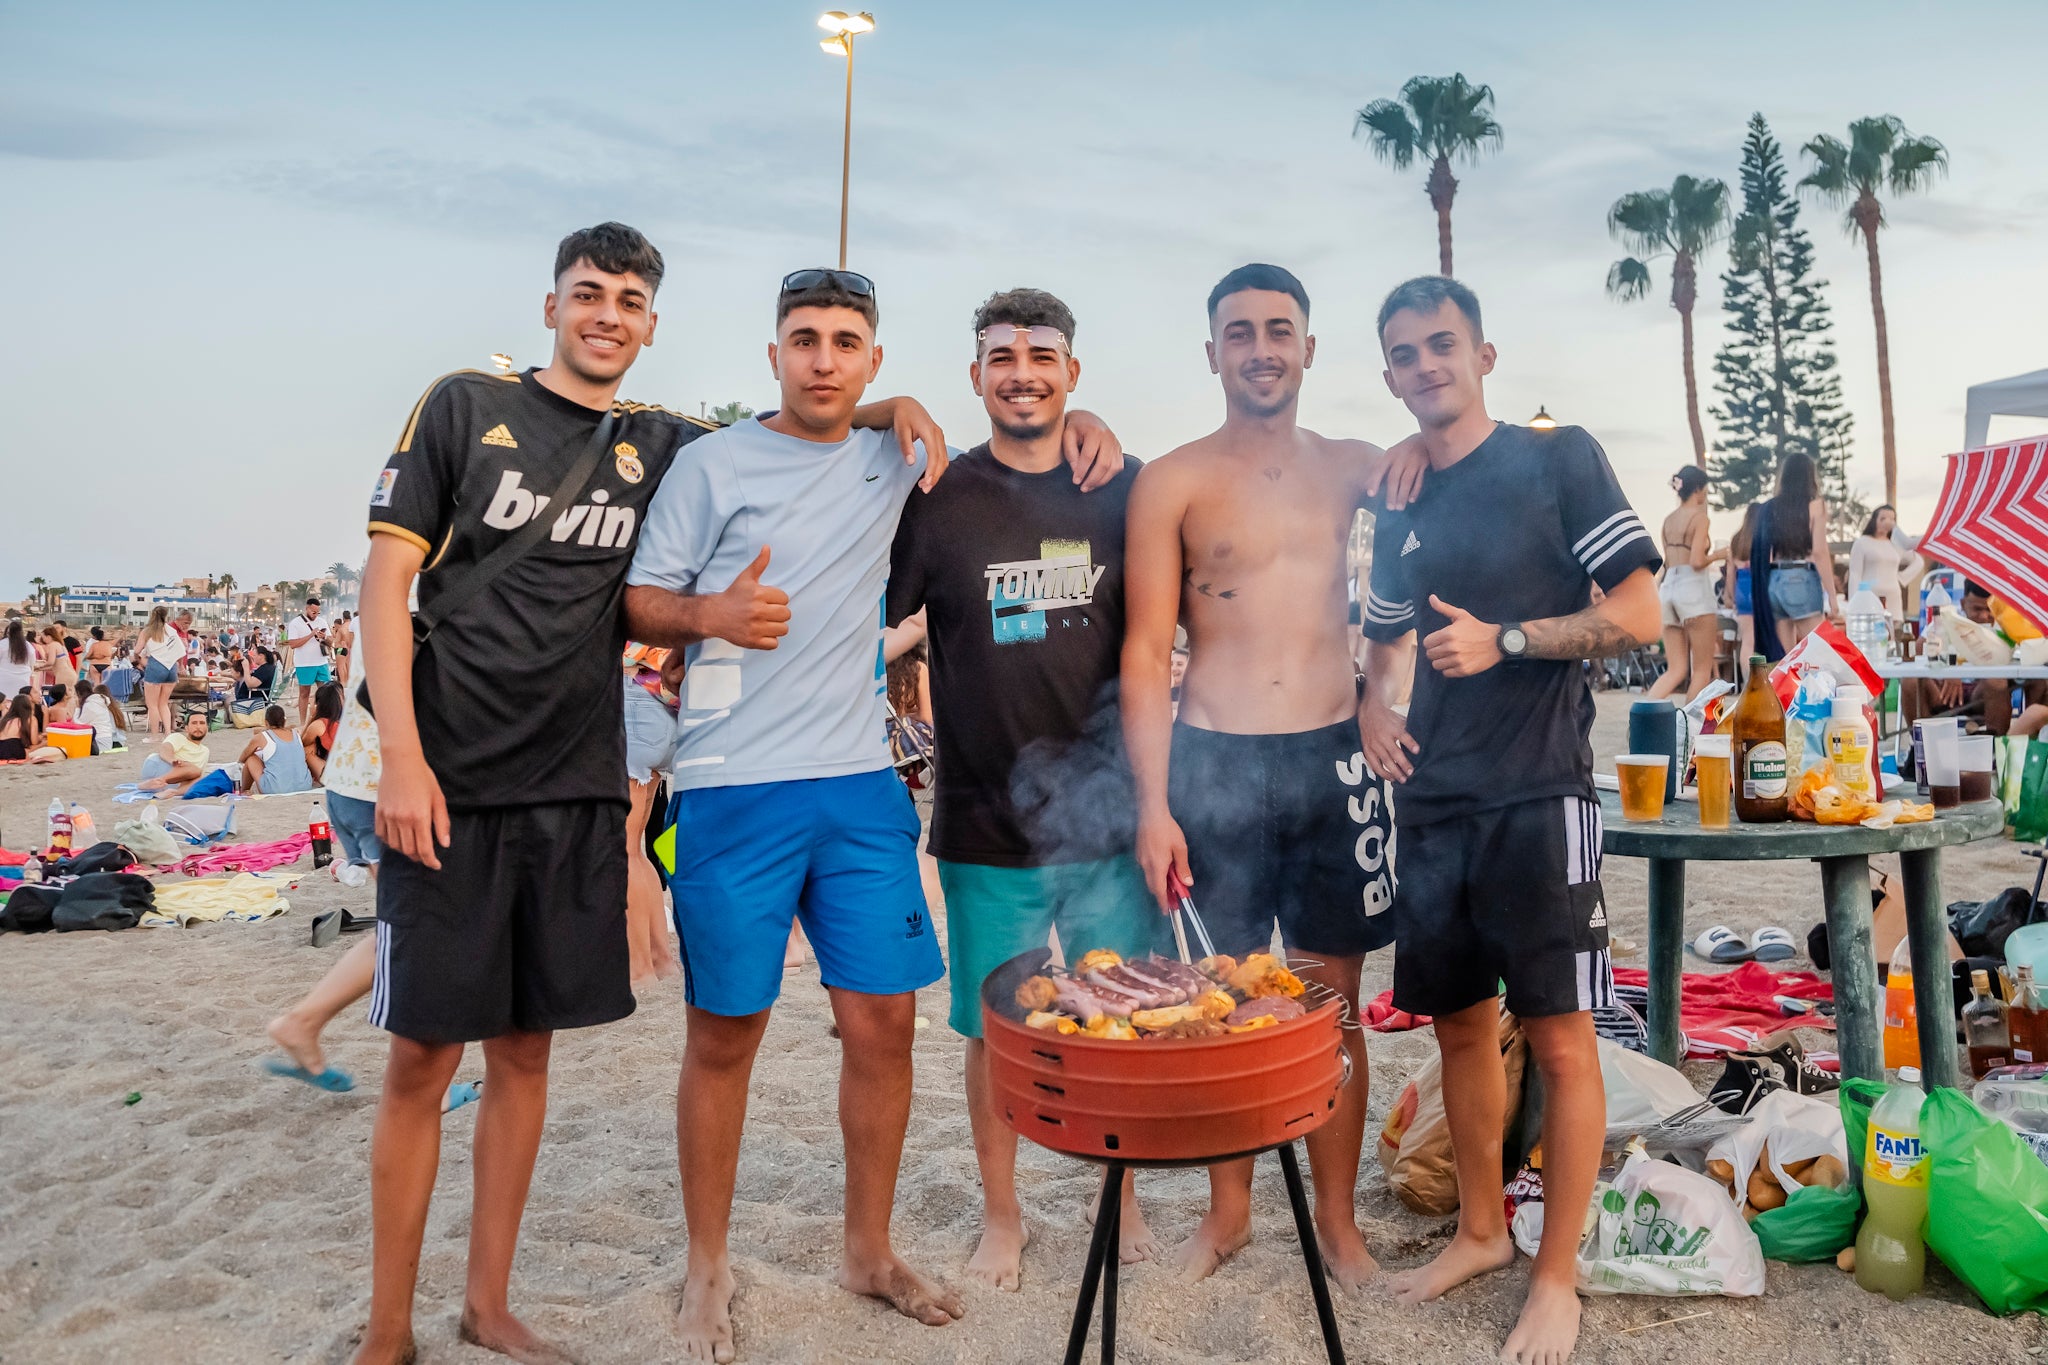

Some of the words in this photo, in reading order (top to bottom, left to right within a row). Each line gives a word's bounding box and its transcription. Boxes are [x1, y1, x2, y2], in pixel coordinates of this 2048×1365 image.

[481, 436, 518, 449] adidas
[1400, 540, 1421, 557] adidas
[984, 565, 1107, 601] TOMMY
[1335, 751, 1393, 917] BOSS
